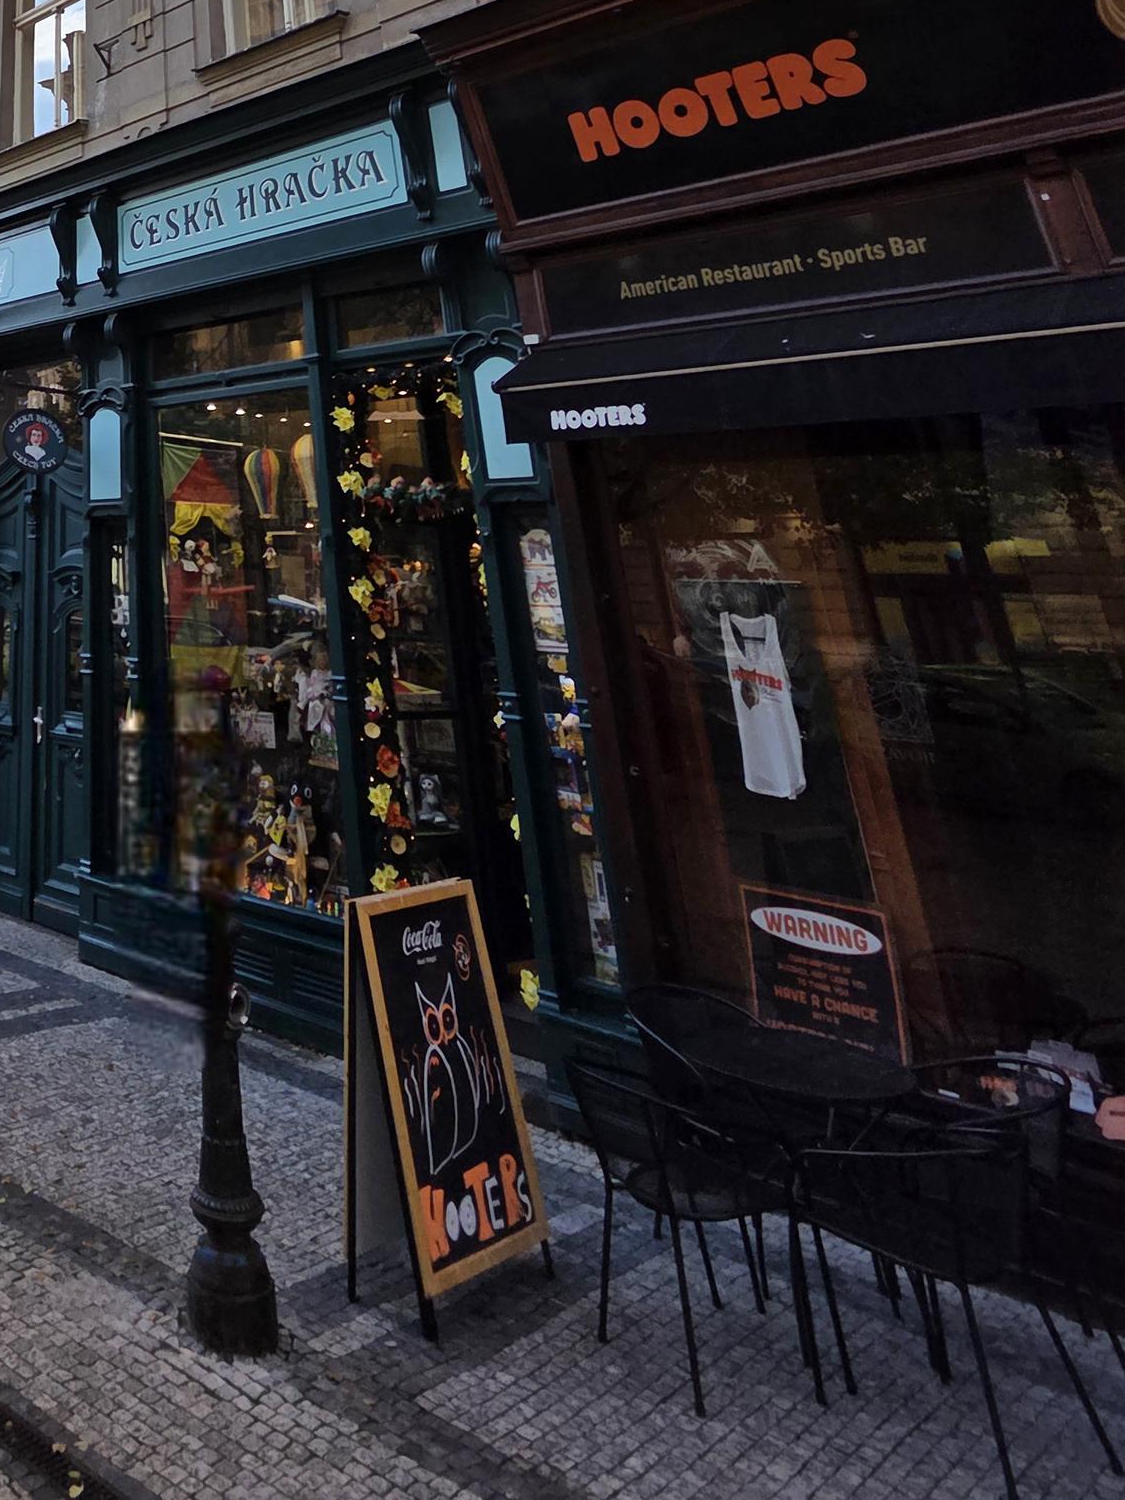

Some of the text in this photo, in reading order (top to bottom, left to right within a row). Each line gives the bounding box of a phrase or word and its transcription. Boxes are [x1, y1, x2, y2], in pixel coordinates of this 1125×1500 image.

[567, 38, 867, 163] HOOTERS
[129, 149, 386, 251] ČESKÁ HRAČKA
[620, 272, 699, 301] American
[700, 254, 804, 288] Restaurant
[816, 241, 887, 271] Sports
[888, 236, 928, 258] Bar
[550, 403, 646, 430] HOOTERS
[762, 909, 869, 952] WARNING
[418, 1153, 534, 1262] HOOTERS
